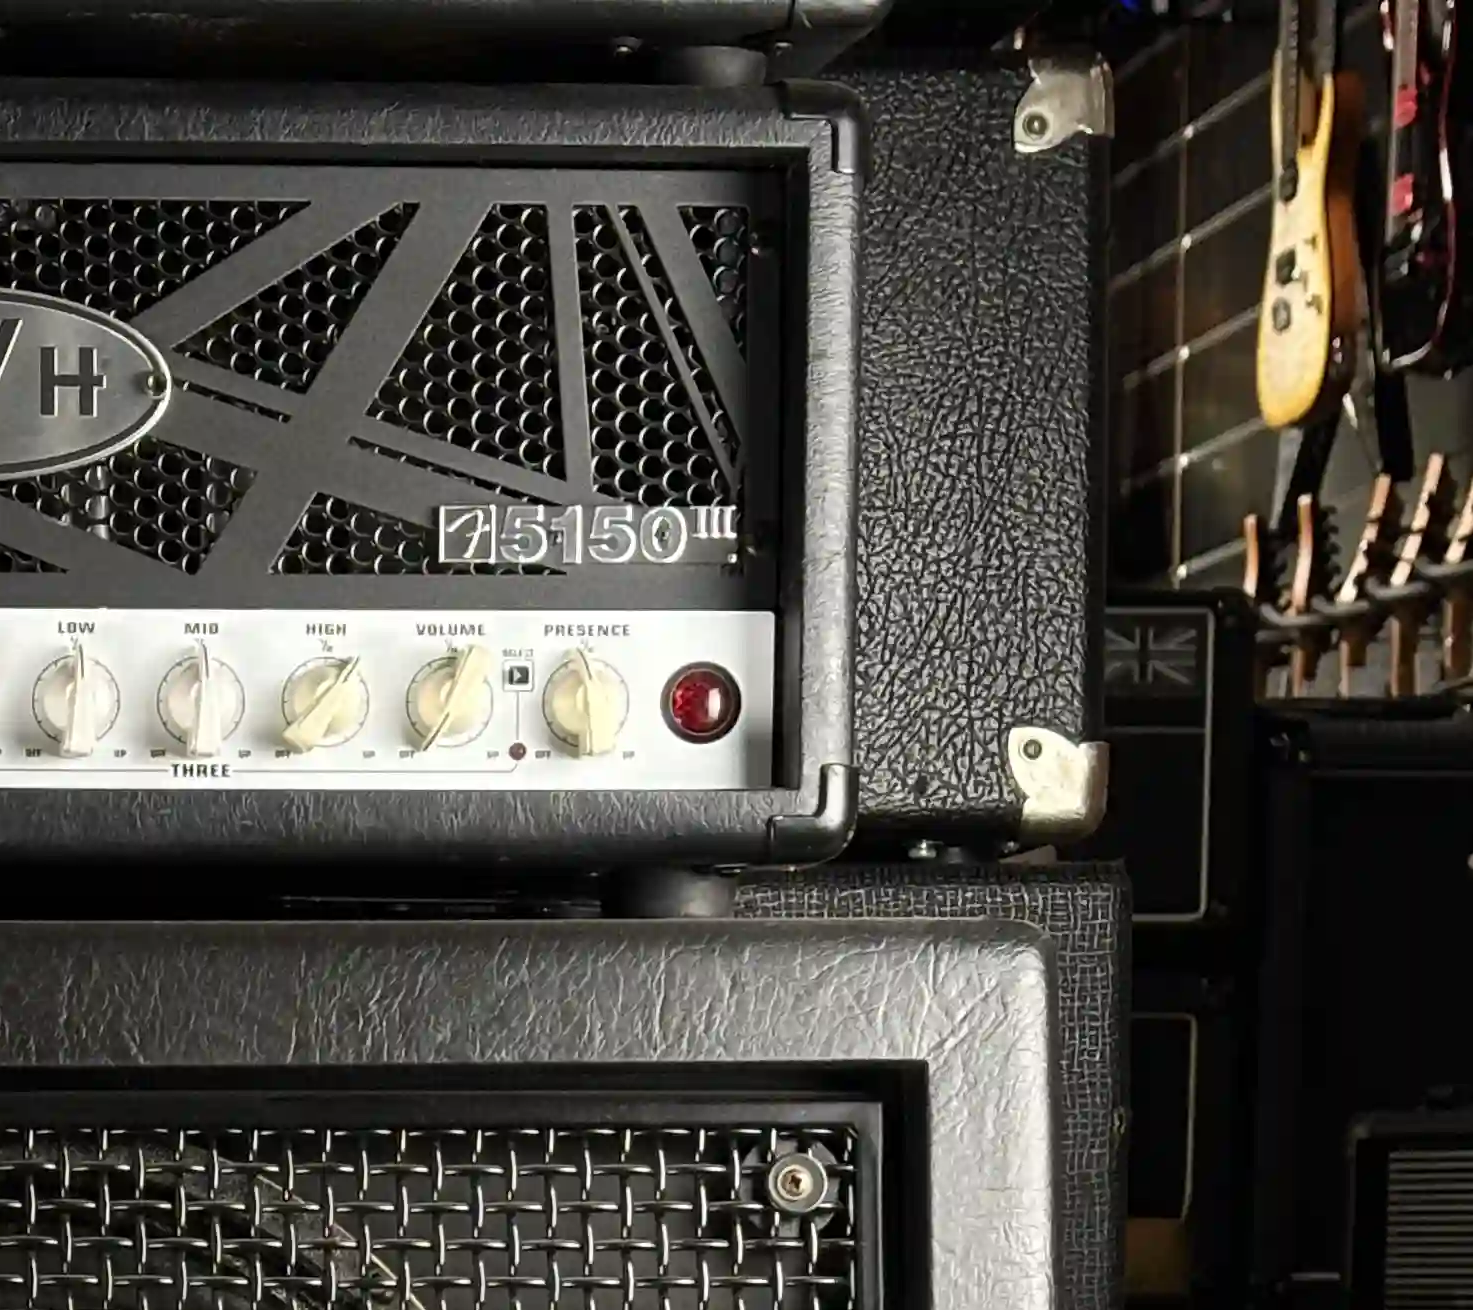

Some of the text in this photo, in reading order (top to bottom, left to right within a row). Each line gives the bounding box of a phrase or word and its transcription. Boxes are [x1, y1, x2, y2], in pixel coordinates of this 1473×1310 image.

[57, 621, 96, 635] LOW
[184, 622, 220, 635] MID
[306, 623, 348, 637] HIGH
[416, 623, 486, 637] VOLUME
[544, 624, 631, 637] PRESENCE
[171, 763, 230, 778] THREE
